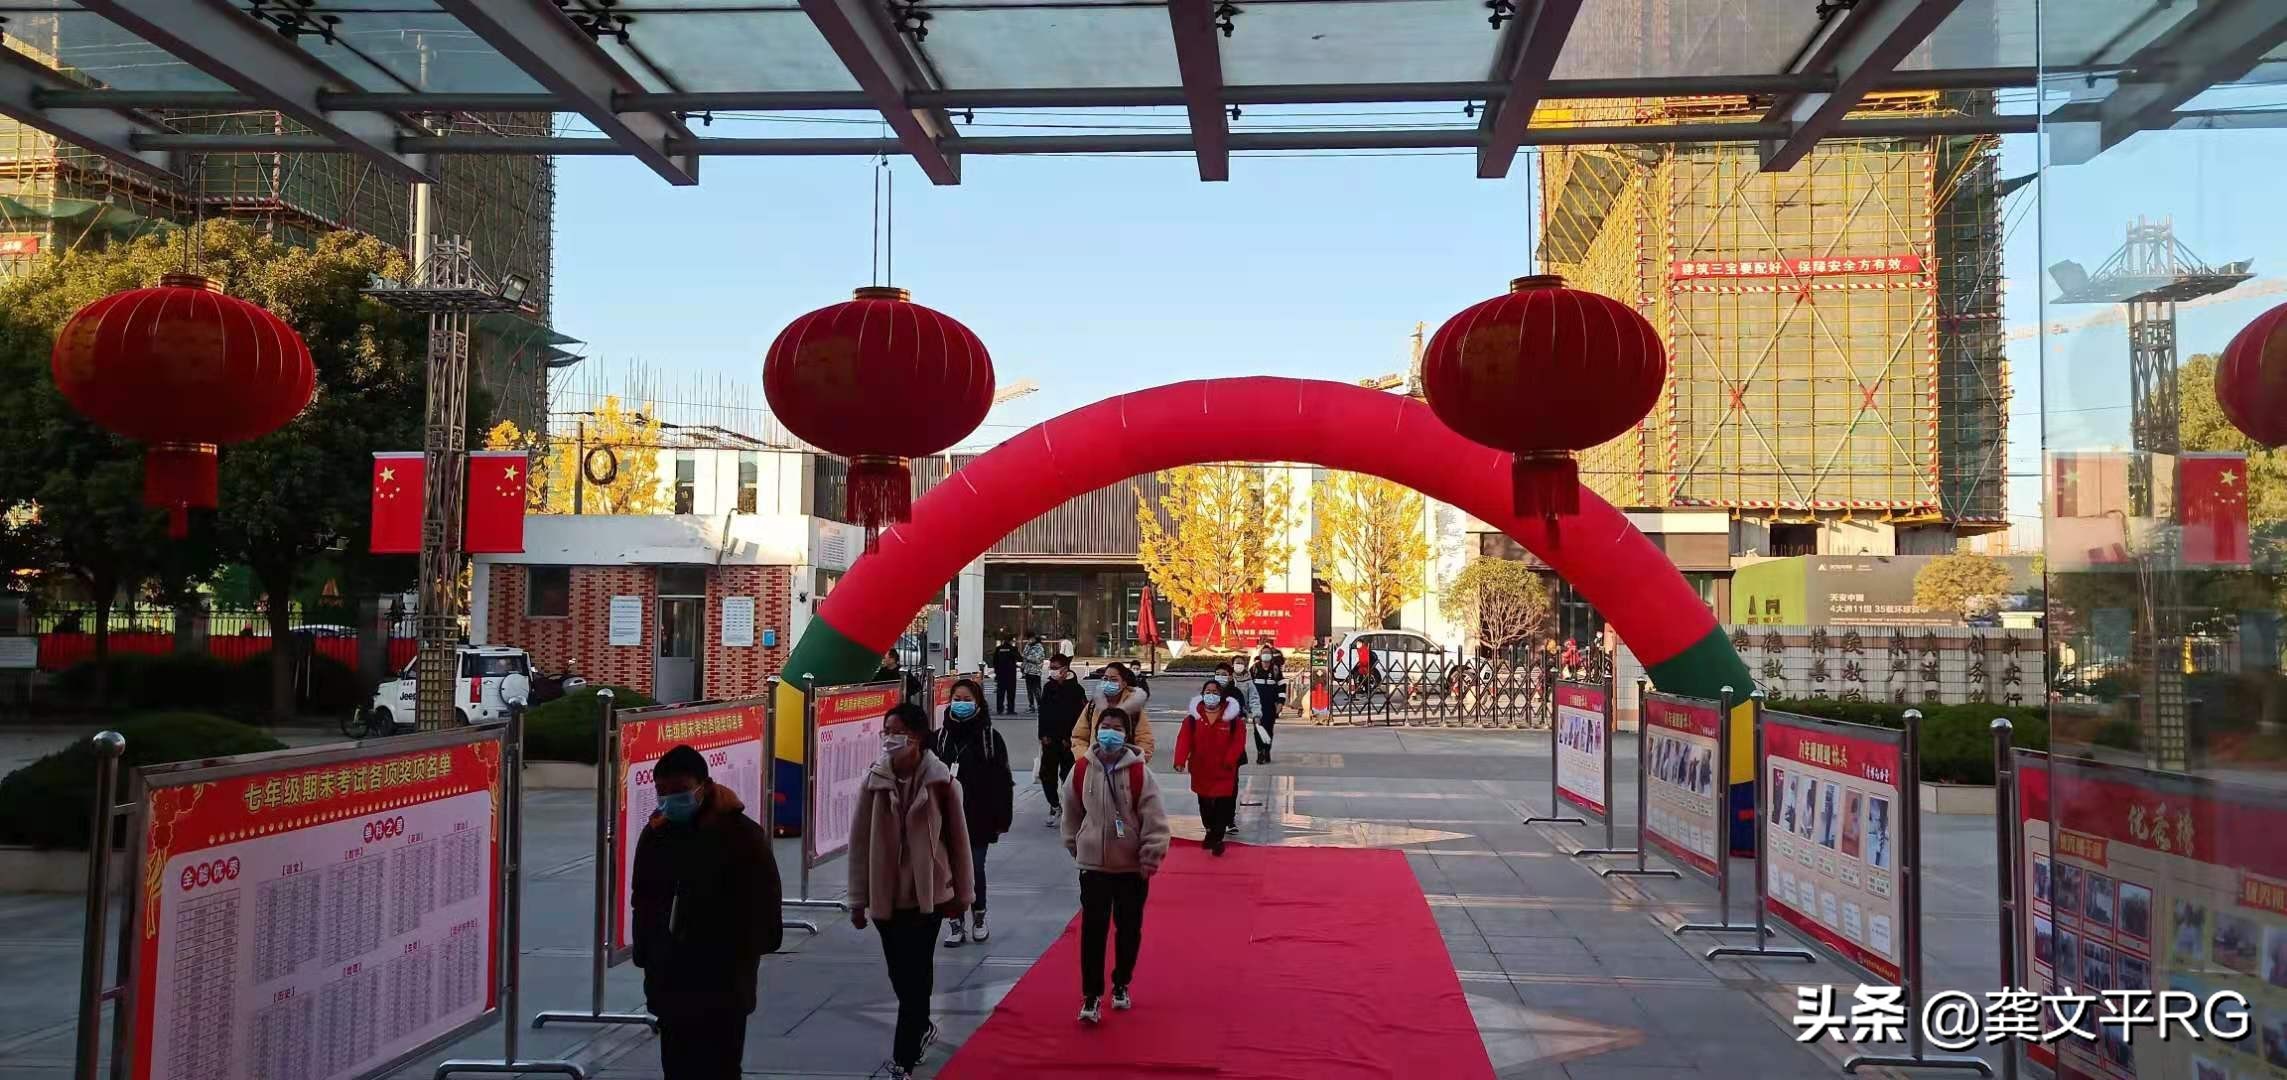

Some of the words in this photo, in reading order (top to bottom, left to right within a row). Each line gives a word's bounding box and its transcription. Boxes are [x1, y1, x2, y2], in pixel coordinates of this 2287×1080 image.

[1968, 633, 2021, 659] 创新
[1968, 661, 2023, 687] 务实
[244, 752, 453, 813] 七年级期末考试各项奖项名单
[182, 858, 240, 890] 全能优秀
